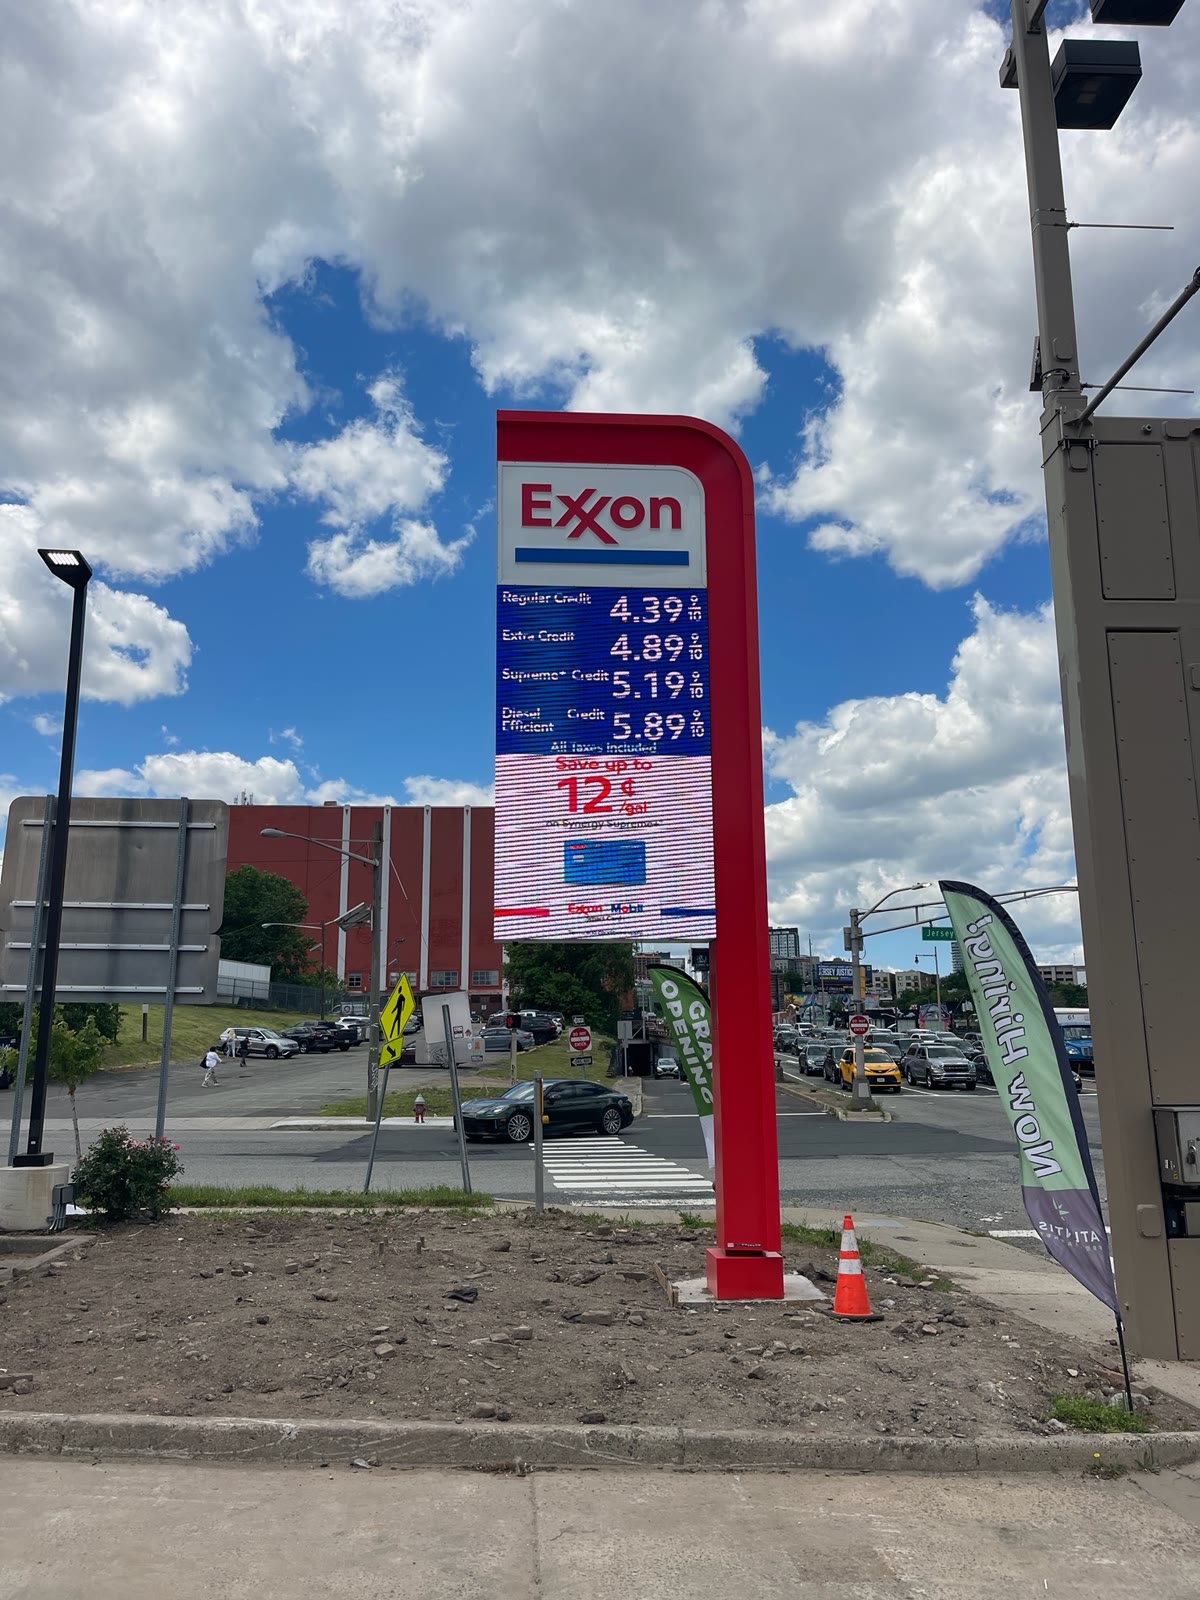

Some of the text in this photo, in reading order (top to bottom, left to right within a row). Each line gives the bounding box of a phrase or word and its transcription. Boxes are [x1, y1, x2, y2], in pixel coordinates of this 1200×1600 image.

[521, 483, 682, 545] Exxon
[502, 591, 702, 624] Regular Credit 4.39 9 10
[502, 629, 703, 662] Extra Credit 4.89 9 10
[571, 669, 610, 682] Credit
[612, 670, 686, 699] 5.19
[691, 670, 701, 683] 9
[689, 686, 704, 699] 10
[502, 706, 705, 741] Diesel Credit 5.89 9 10
[502, 719, 555, 733] Efficient
[550, 740, 657, 754] All Taxes included
[555, 756, 653, 775] Save up to
[557, 776, 613, 814] 12
[926, 929, 954, 939] Jersey
[836, 967, 853, 976] JUSTIC
[661, 980, 713, 1105] OPENING
